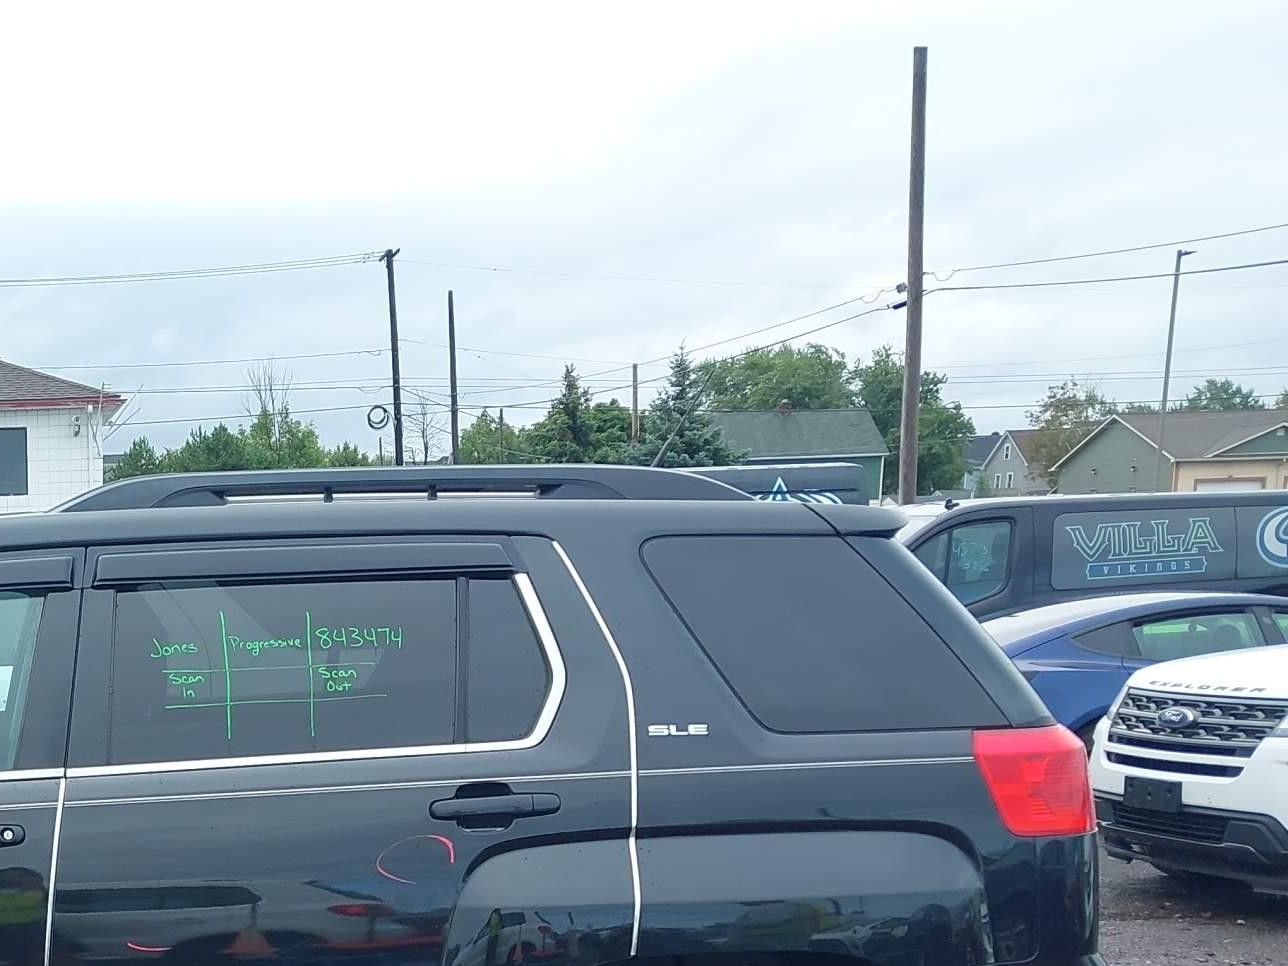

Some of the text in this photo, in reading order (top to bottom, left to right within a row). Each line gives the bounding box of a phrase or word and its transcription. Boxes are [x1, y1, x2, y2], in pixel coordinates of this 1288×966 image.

[1065, 518, 1224, 562] VILLA
[315, 627, 402, 650] 843474
[150, 637, 198, 658] Jones
[227, 636, 302, 656] Progressive
[168, 673, 205, 685] Scan
[318, 667, 357, 679] Scan
[326, 680, 352, 692] Out
[1149, 680, 1267, 693] EXPLORER
[1161, 710, 1185, 722] Ford
[648, 724, 709, 736] SLE
